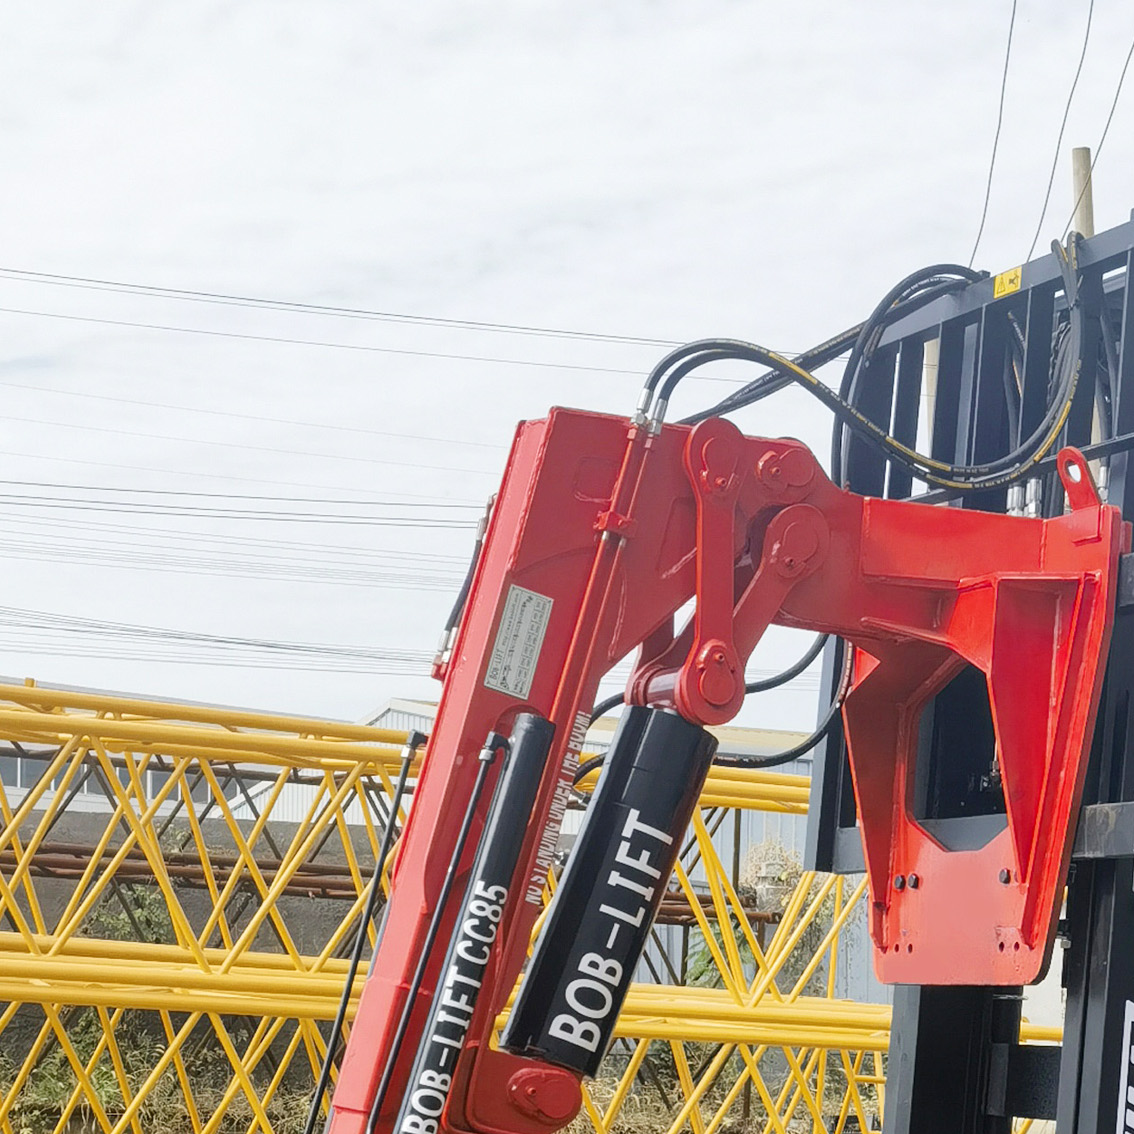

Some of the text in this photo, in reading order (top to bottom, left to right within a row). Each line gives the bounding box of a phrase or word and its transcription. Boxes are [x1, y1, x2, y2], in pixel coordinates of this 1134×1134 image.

[525, 883, 543, 905] NO
[535, 820, 558, 884] STANDING
[550, 779, 574, 826] UNDER
[457, 879, 508, 966] CC85
[549, 809, 674, 1053] BOB-LIFT
